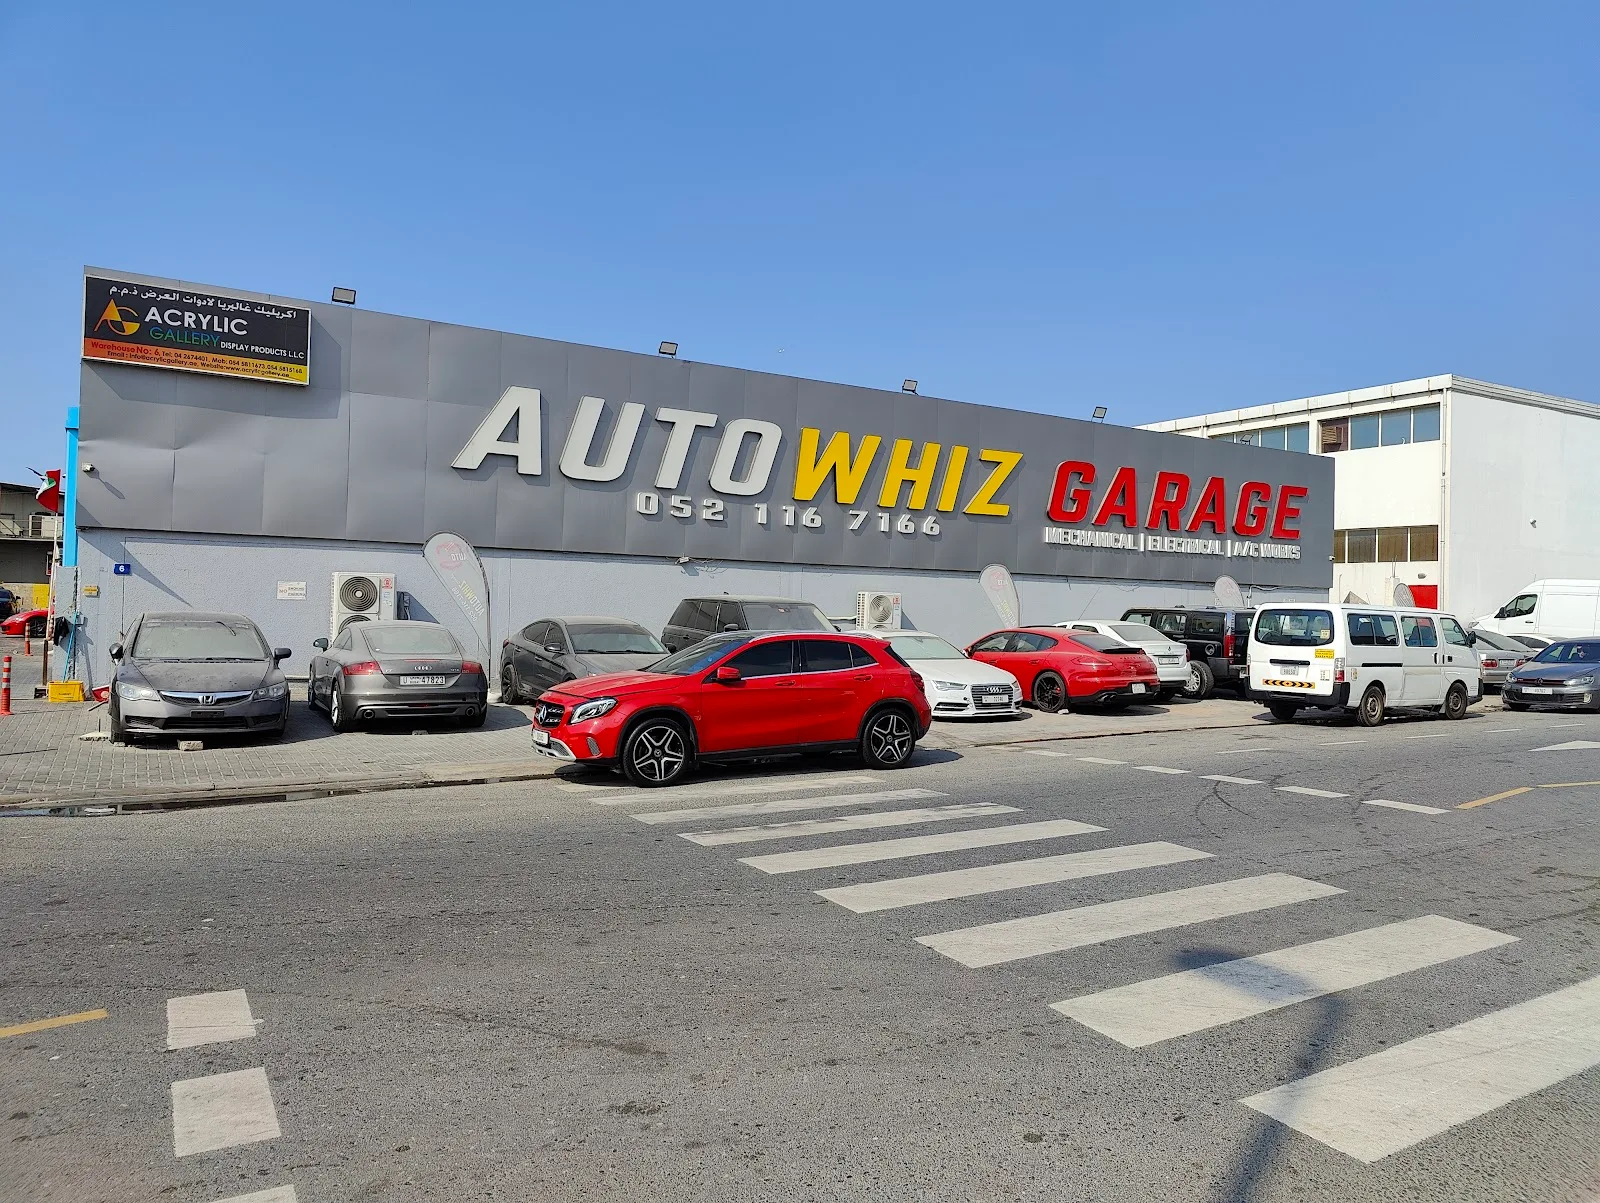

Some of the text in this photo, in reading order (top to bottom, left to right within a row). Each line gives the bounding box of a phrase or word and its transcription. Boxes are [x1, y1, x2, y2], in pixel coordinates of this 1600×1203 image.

[140, 289, 180, 301] العرض
[144, 306, 248, 335] ACRYLIC
[91, 341, 135, 353] Warehouse
[136, 346, 152, 355] No:
[149, 326, 305, 359] GALLERY DISPLAY PRODUCTS L.L.C
[637, 492, 941, 537] 052 116 7166
[1046, 460, 1309, 540] GARAGE
[1043, 526, 1301, 561] MECHANICAL ELECTRICAL A/C WORKS
[118, 564, 126, 573] 6
[421, 675, 444, 684] 47823
